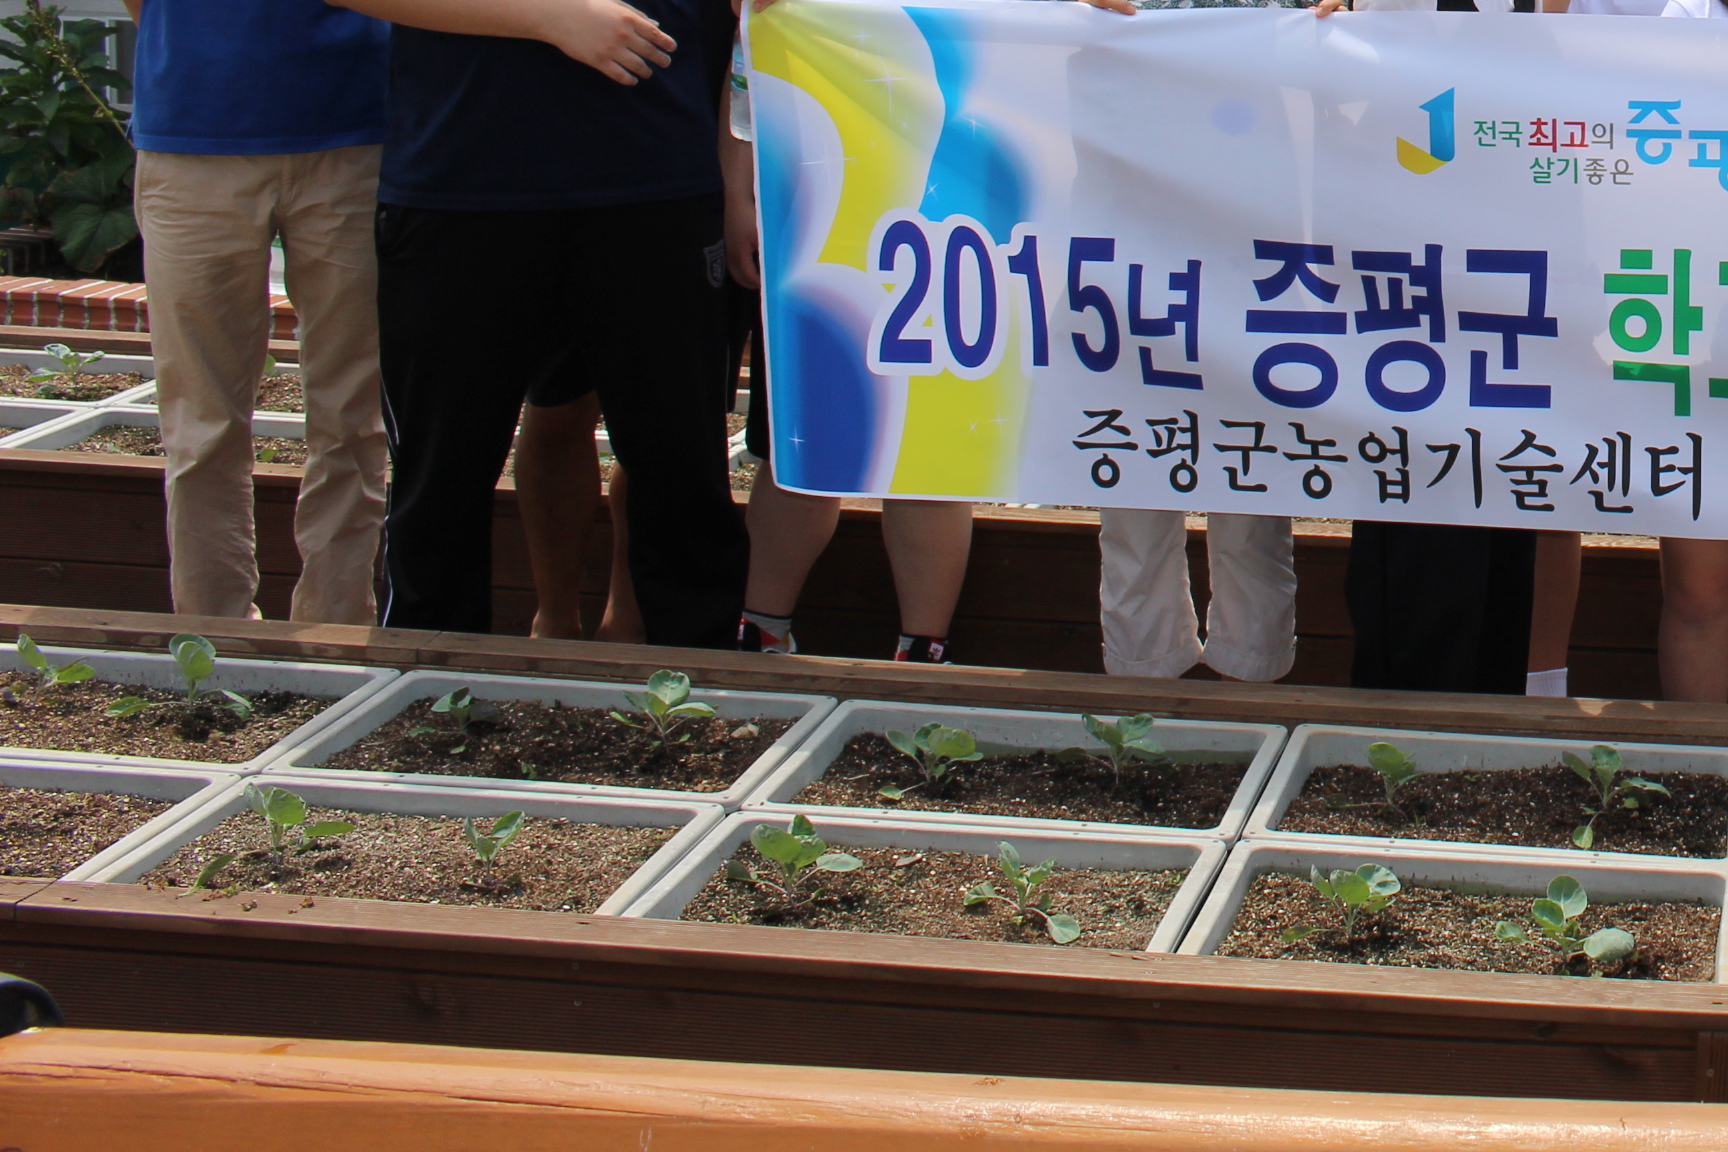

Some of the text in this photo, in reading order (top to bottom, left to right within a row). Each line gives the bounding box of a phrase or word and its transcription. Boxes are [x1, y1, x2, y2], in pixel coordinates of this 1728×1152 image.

[1473, 119, 1523, 148] 전국
[1528, 117, 1615, 152] 최고의
[878, 219, 1204, 390] 2015년
[1245, 238, 1559, 412] 증평군
[1072, 409, 1703, 520] 증평군농업기술센터
